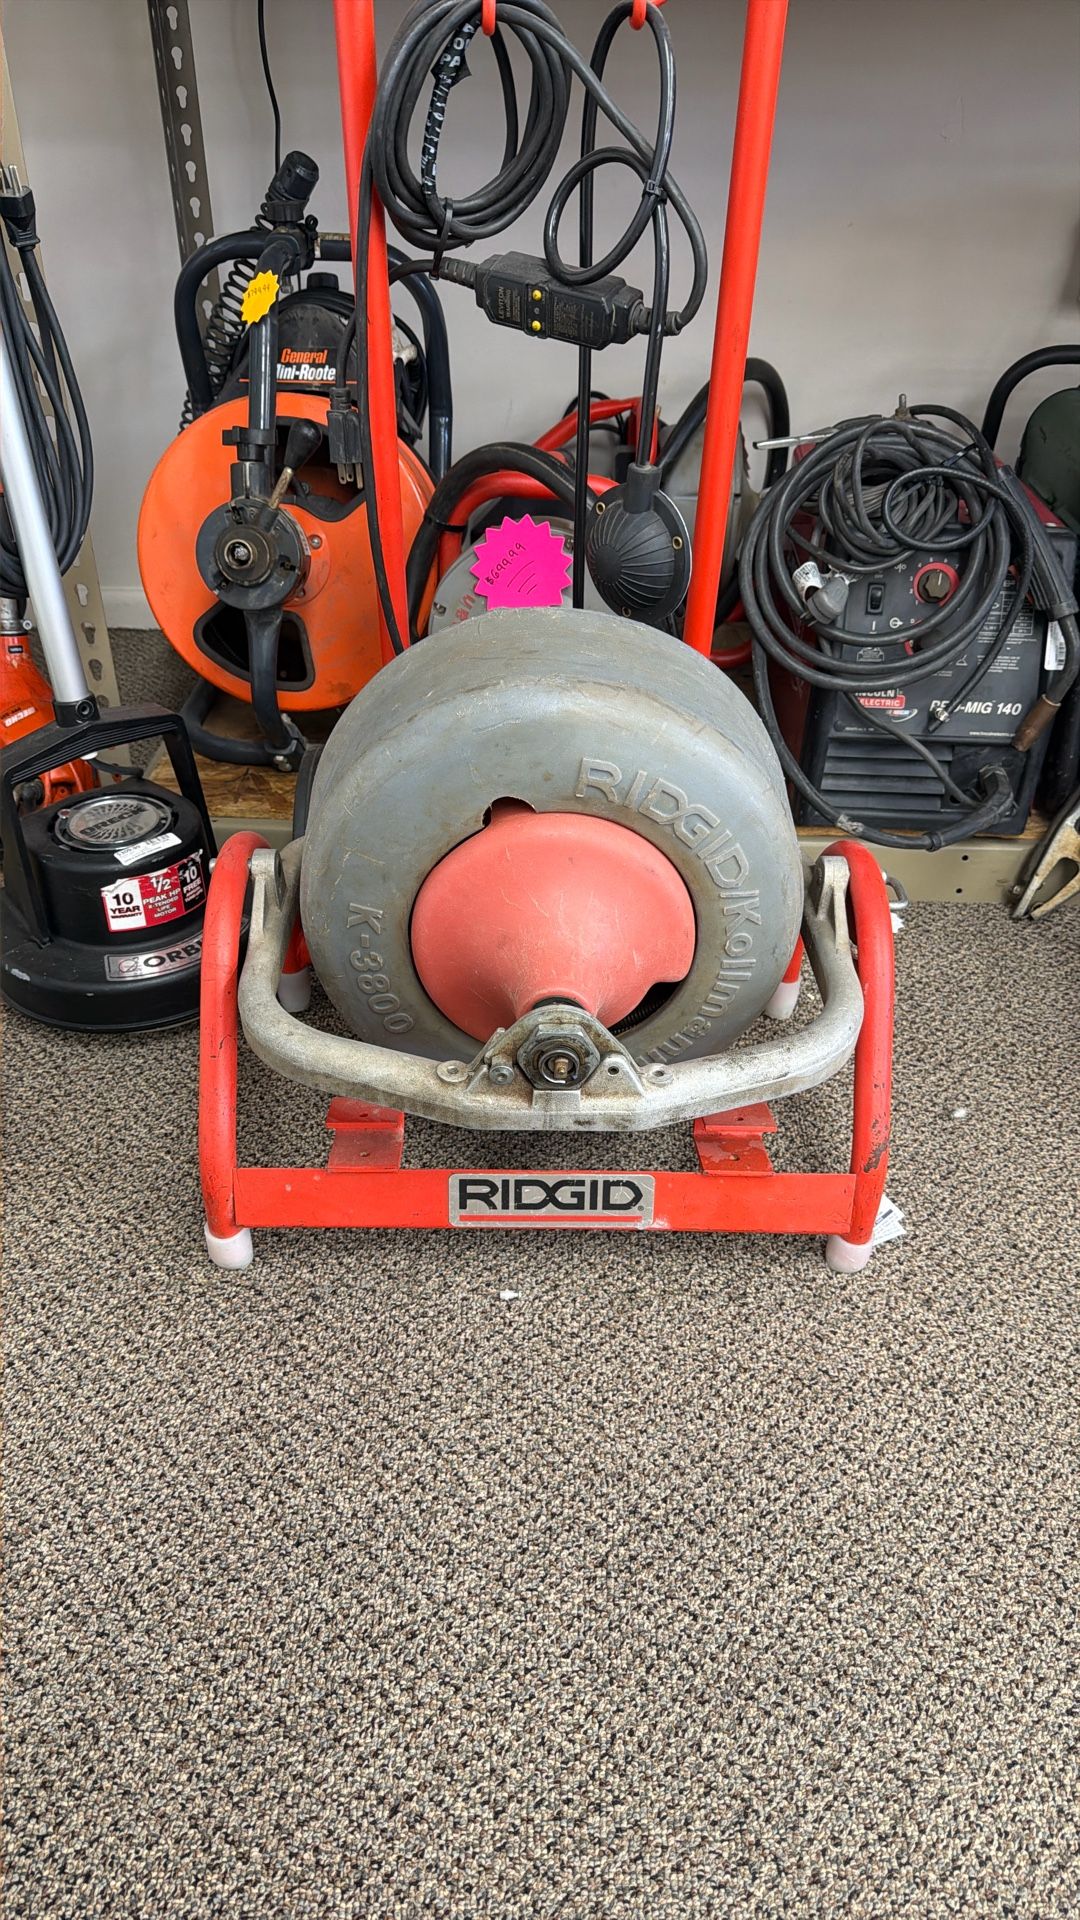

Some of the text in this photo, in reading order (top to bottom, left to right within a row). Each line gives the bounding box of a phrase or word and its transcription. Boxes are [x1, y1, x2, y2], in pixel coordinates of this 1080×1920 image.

[281, 348, 328, 364] General
[276, 363, 336, 380] ini-Roote
[485, 542, 527, 585] $699.99
[860, 697, 901, 707] ELECTRIC
[997, 702, 1022, 716] 140
[575, 757, 750, 889] RIDGID
[183, 865, 198, 884] 10
[150, 875, 172, 893] 1/2
[183, 877, 202, 894] FREE
[112, 892, 134, 906] 10
[143, 887, 181, 905] PEAK HP
[110, 905, 141, 915] YEAR
[154, 907, 177, 918] MOTOR
[346, 902, 415, 1034] K-3800
[459, 1179, 643, 1211] RIDGID
